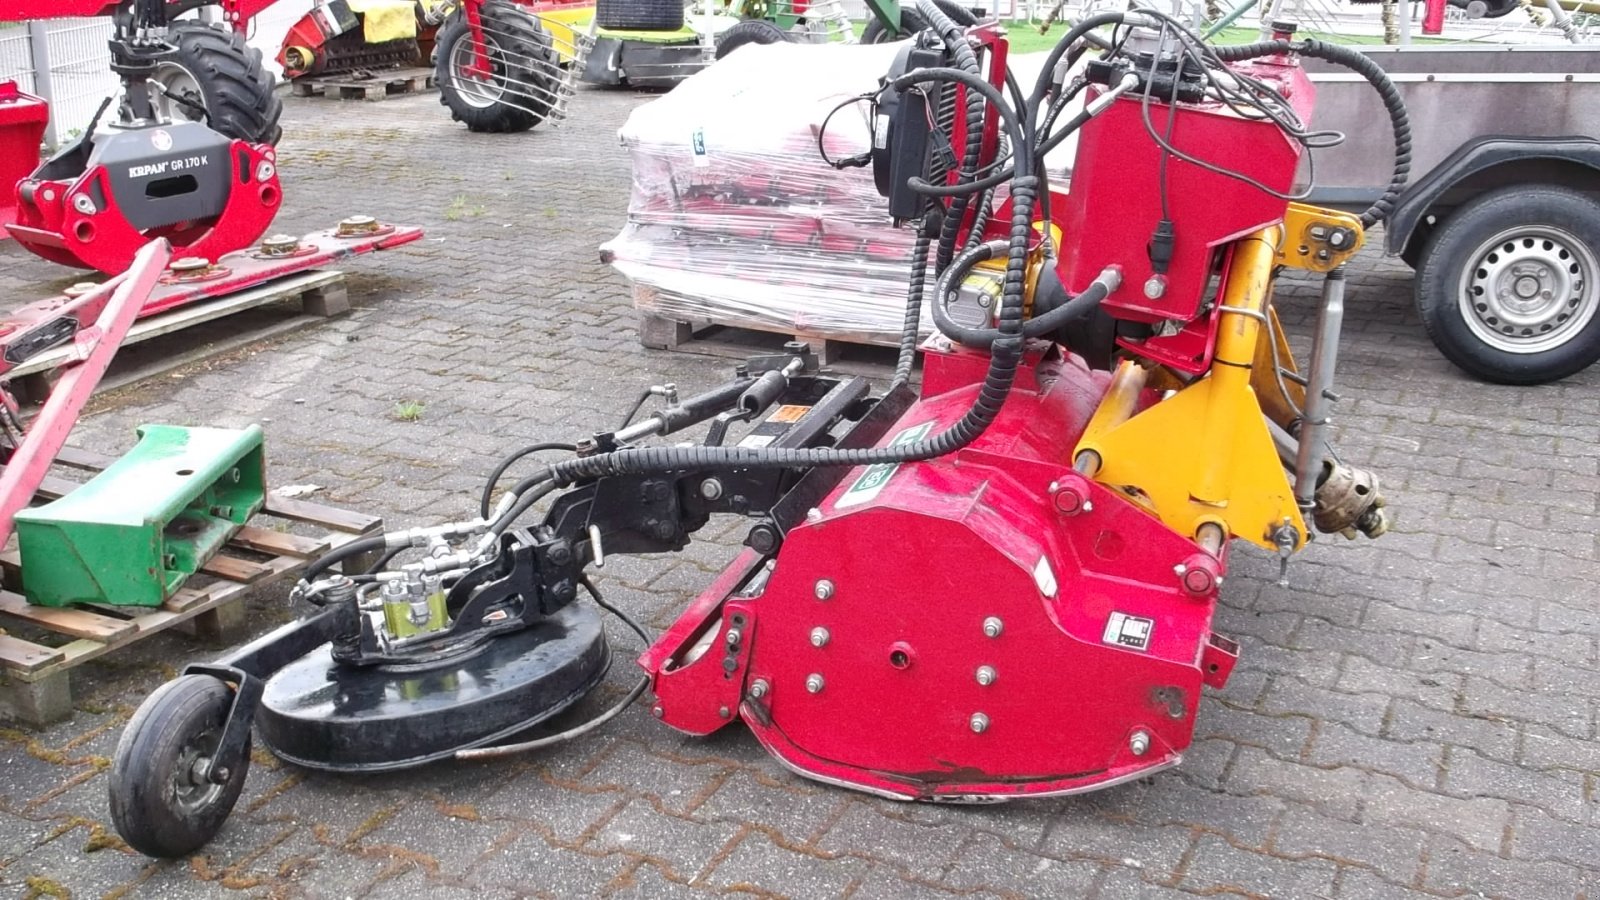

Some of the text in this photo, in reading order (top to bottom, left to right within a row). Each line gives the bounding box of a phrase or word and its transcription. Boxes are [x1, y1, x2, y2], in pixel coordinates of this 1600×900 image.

[171, 160, 183, 170] GR
[185, 156, 200, 168] 170
[201, 155, 208, 165] K
